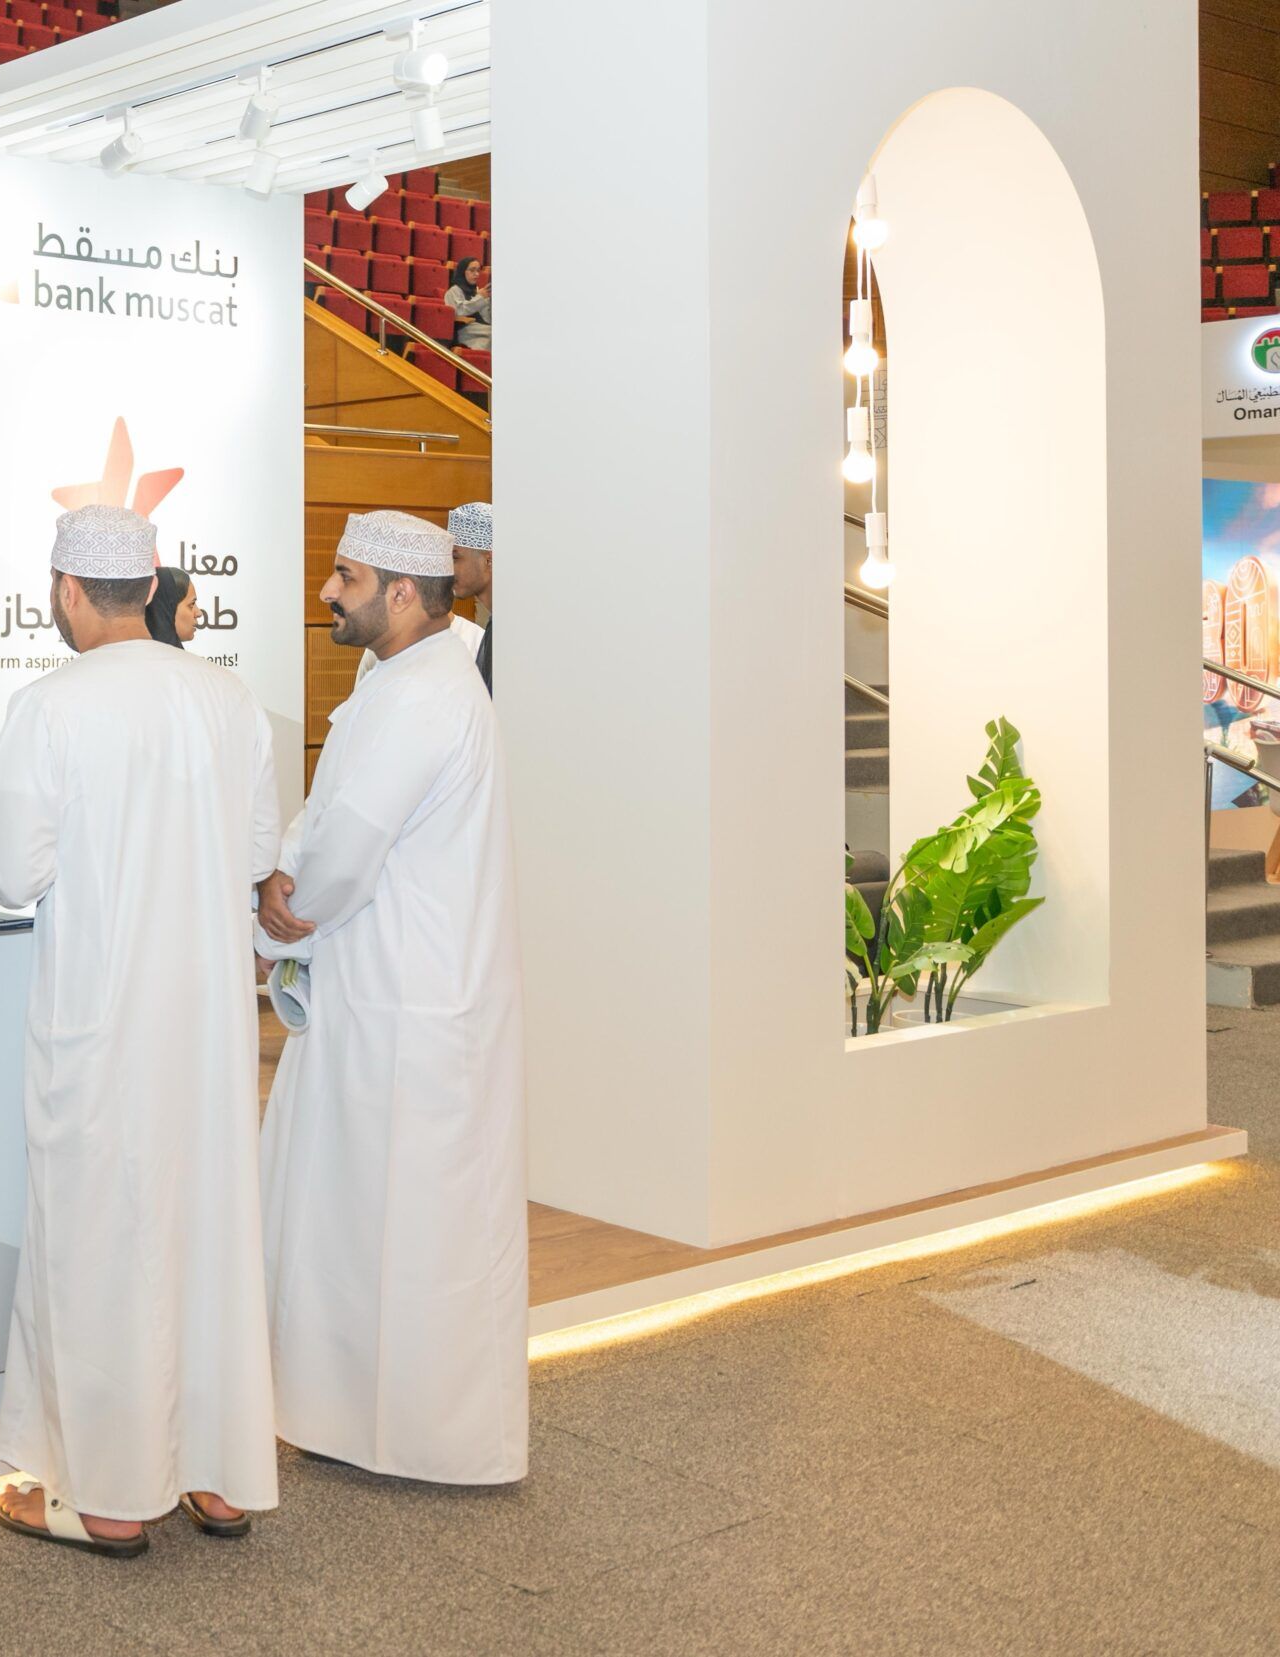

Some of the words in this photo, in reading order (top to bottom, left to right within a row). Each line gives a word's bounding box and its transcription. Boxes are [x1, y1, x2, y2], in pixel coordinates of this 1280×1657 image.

[34, 223, 161, 269] مسقط
[171, 240, 238, 288] بنك
[35, 270, 115, 314] bank
[126, 293, 237, 327] muscat
[180, 541, 238, 576] معنا
